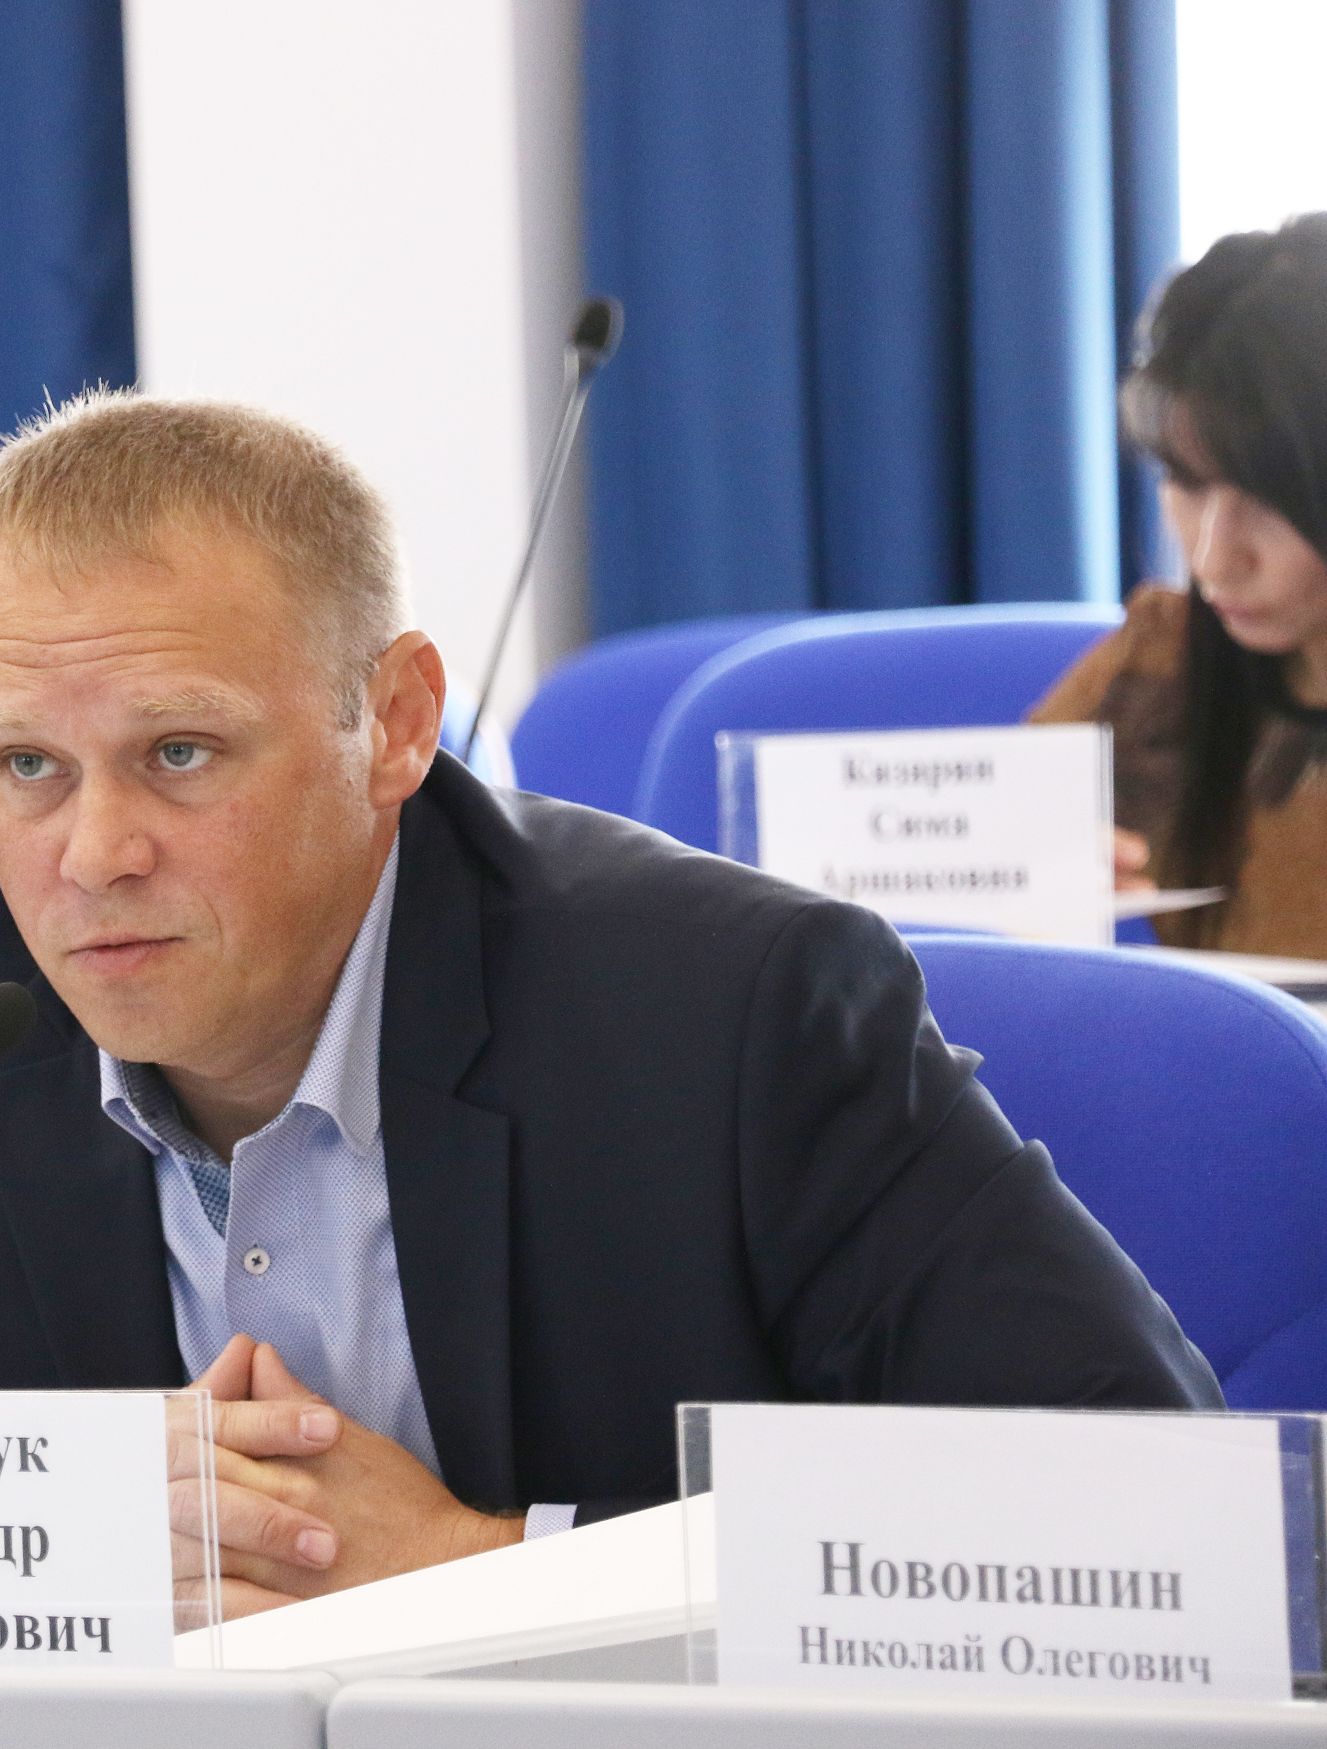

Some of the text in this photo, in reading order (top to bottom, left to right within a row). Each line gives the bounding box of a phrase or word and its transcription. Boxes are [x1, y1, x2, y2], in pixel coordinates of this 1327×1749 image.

[817, 1540, 1184, 1611] Новопашин
[797, 1625, 1213, 1685] Николай Олегович
